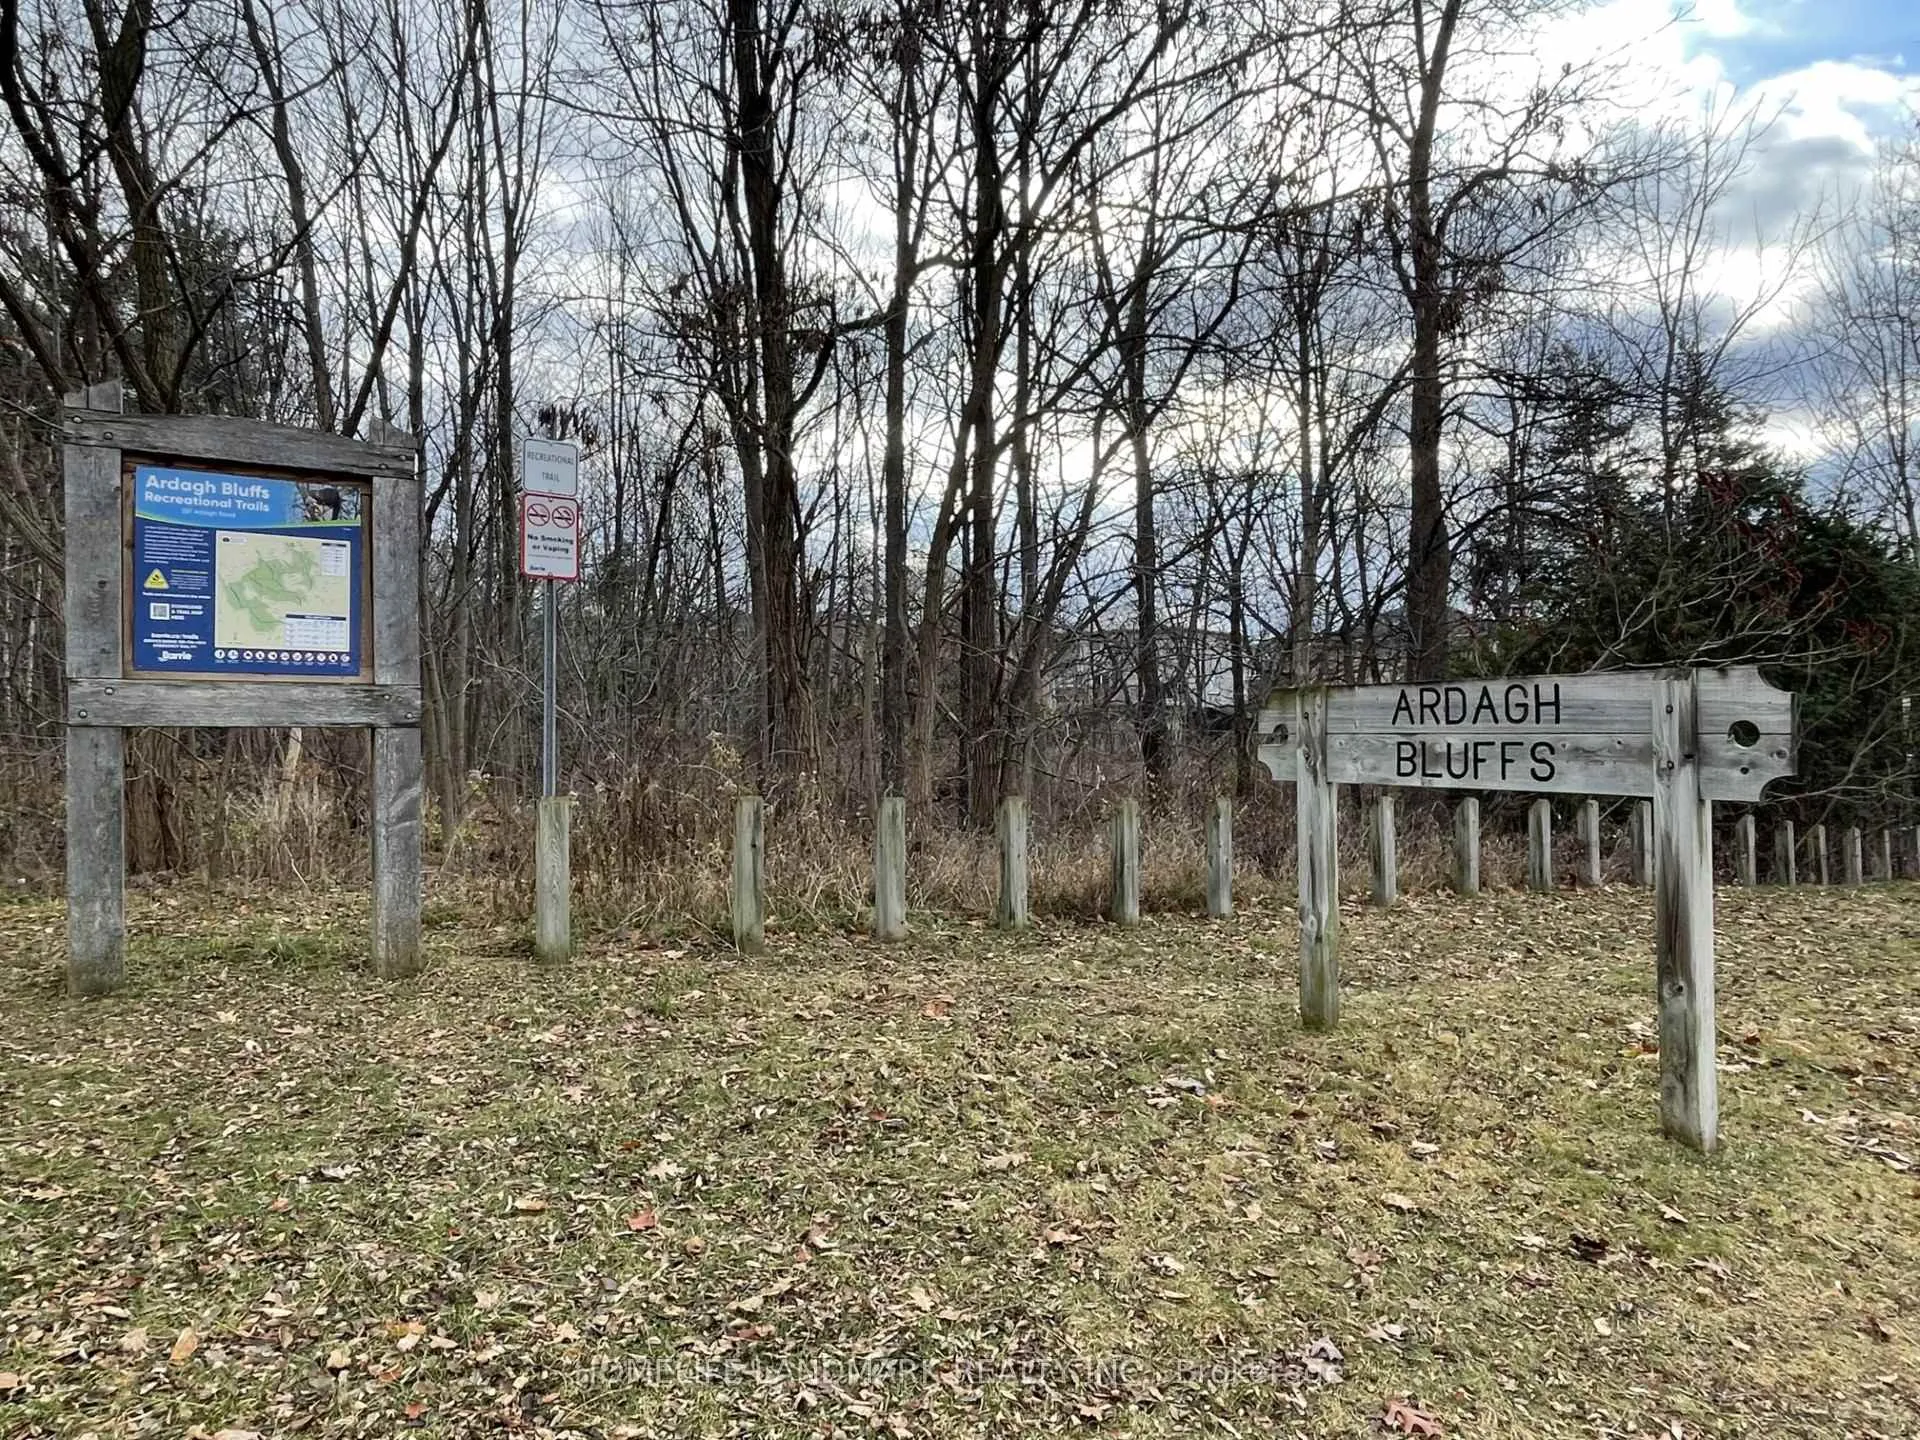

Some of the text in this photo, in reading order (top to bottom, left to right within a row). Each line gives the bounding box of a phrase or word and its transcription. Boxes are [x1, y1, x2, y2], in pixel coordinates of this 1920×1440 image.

[527, 451, 574, 465] RECREATIONAL
[542, 471, 560, 483] TRAIL
[145, 474, 271, 500] Ardagh Bluffs
[144, 491, 270, 513] Recreational Trails
[540, 535, 573, 545] Smoking
[542, 543, 569, 554] Vaping
[161, 650, 193, 661] Barrie
[1391, 682, 1561, 726] ARDAGH
[1395, 740, 1557, 782] BLUFFS
